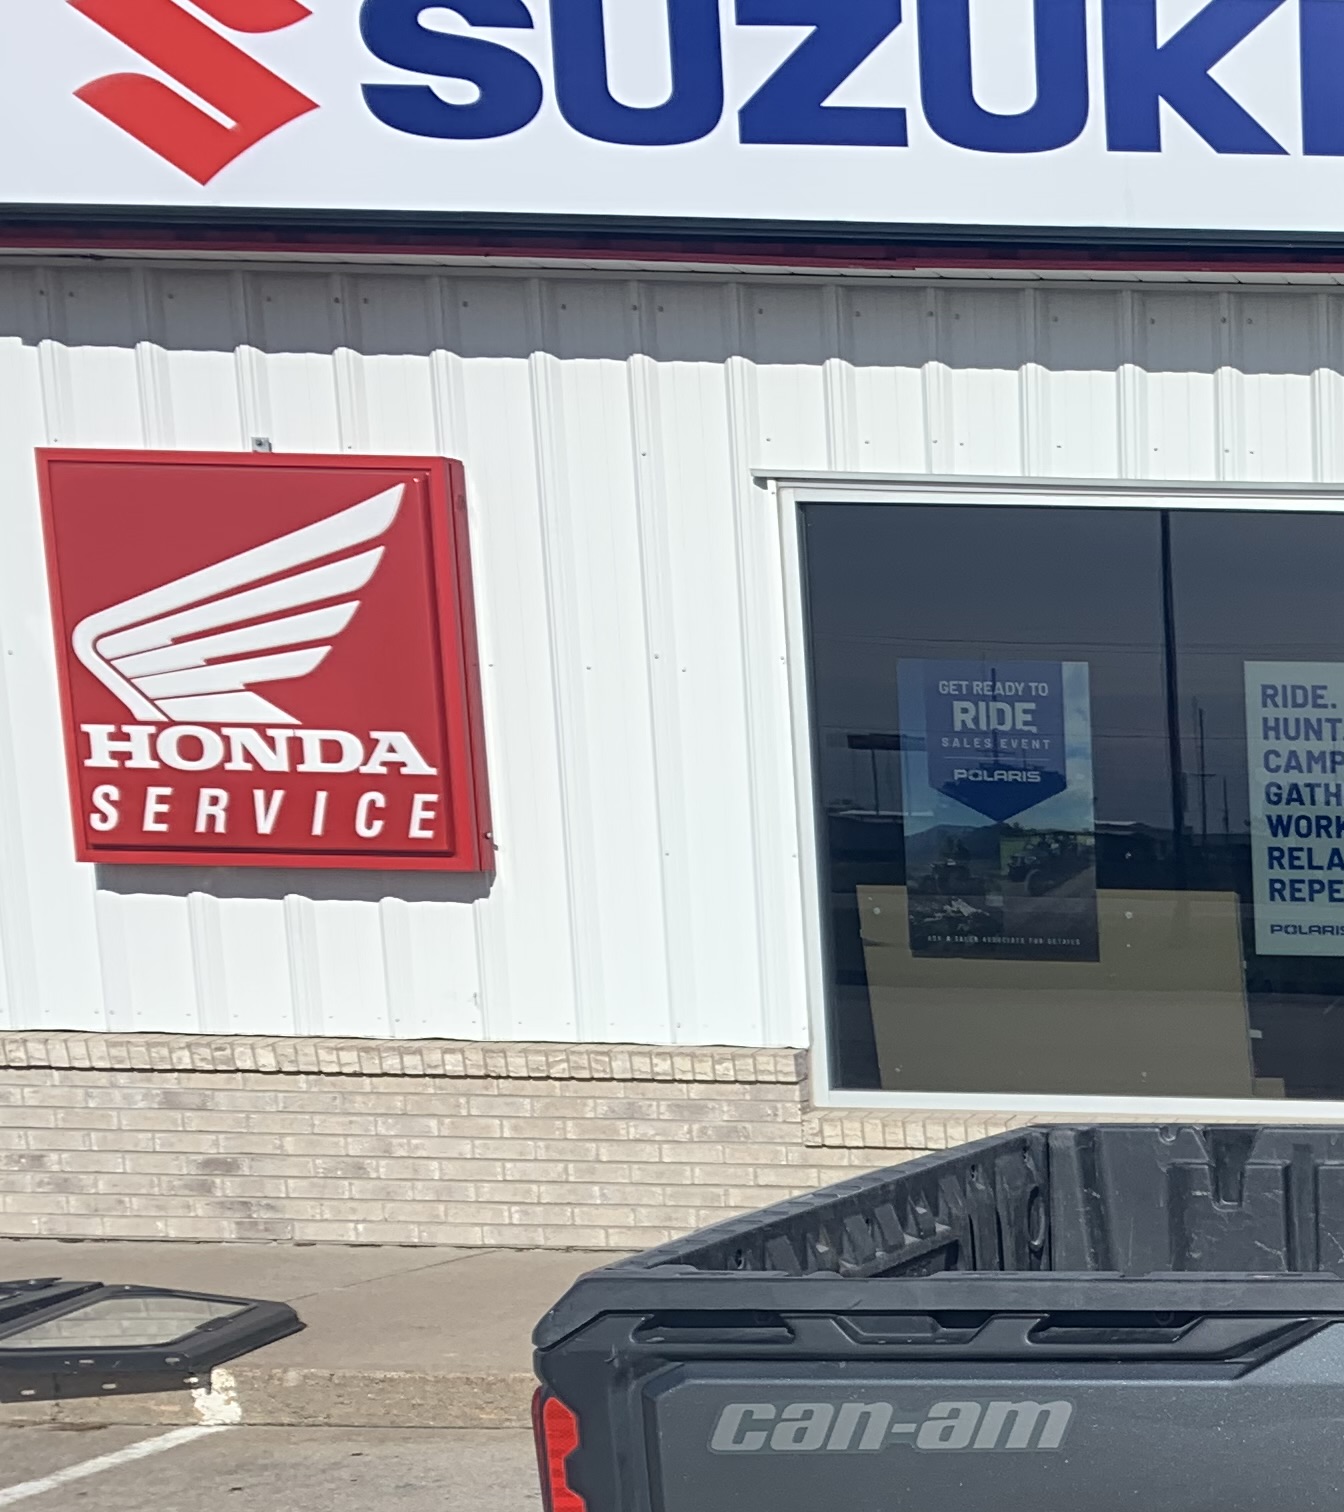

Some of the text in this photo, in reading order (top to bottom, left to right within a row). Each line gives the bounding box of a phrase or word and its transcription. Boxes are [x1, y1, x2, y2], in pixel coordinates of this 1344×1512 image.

[939, 681, 1049, 697] GET READY TO
[1260, 684, 1337, 709] RIDE.
[953, 700, 1038, 733] RIDE
[80, 723, 438, 775] HONDA
[941, 737, 1051, 750] SALES EVENT
[954, 768, 1041, 783] POLARIS
[89, 785, 439, 839] SERVICE
[710, 1400, 1073, 1451] can-am
